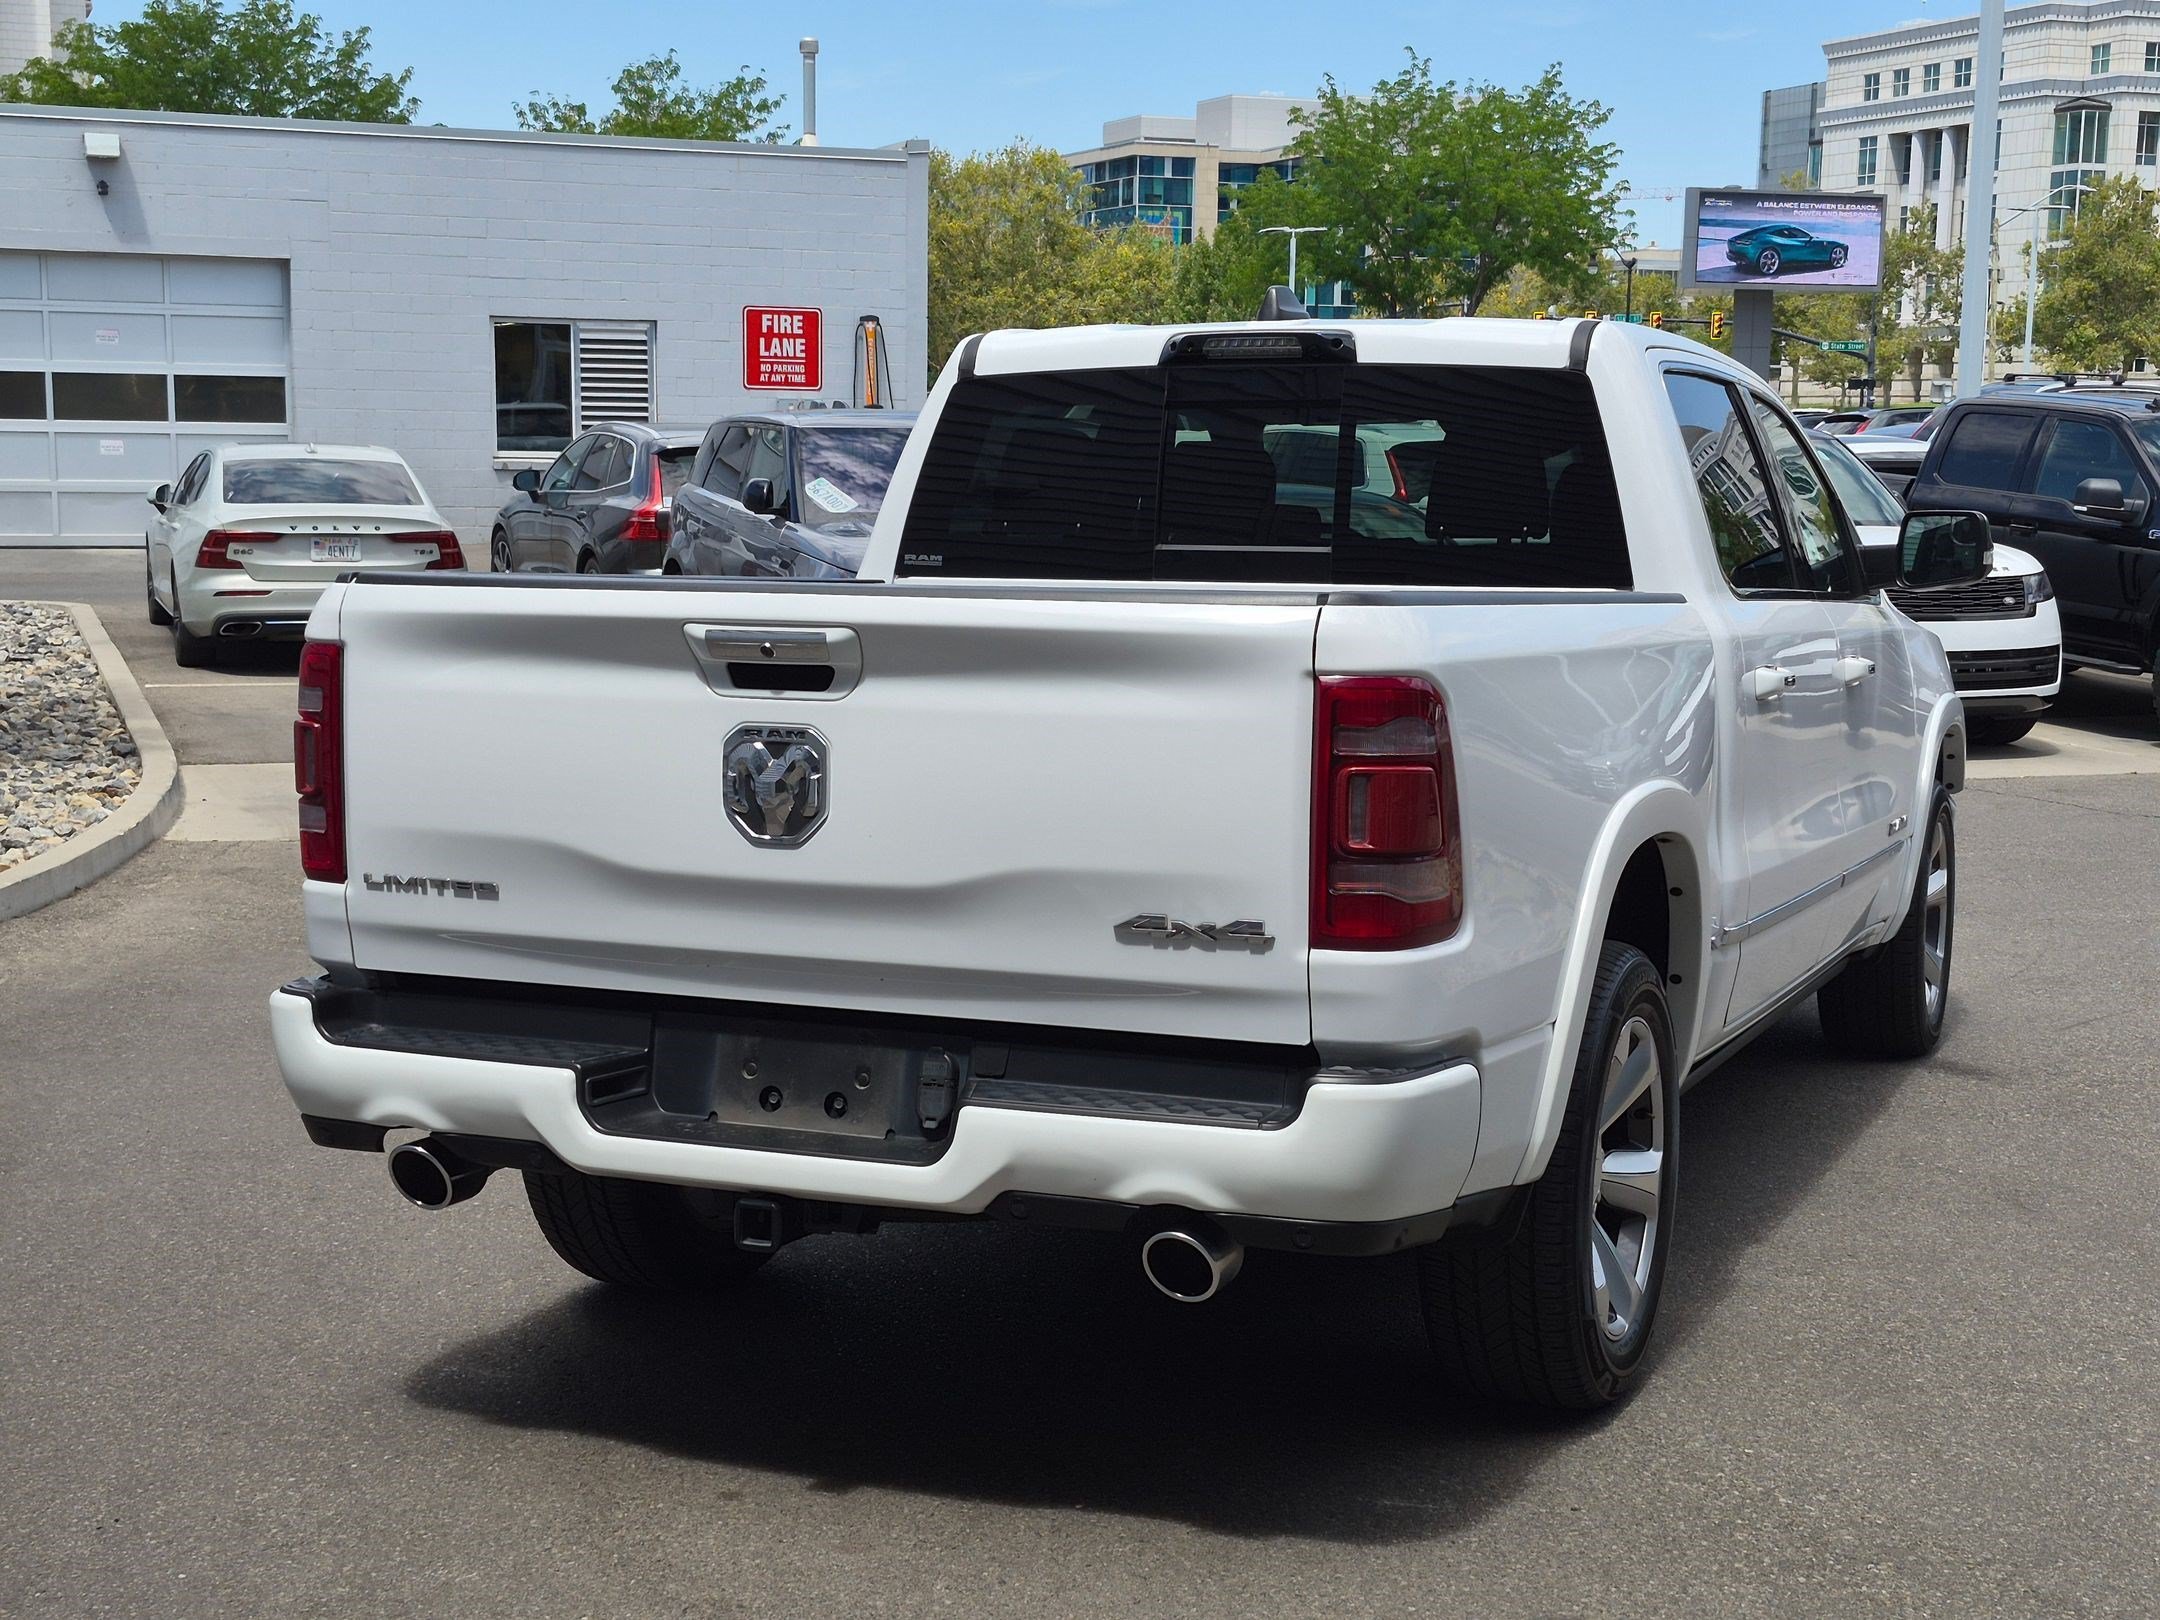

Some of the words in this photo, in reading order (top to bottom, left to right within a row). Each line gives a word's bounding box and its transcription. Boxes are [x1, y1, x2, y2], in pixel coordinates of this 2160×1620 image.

[1763, 201, 1799, 209] BALANCE
[761, 314, 803, 334] FIRE
[759, 337, 806, 357] LANE
[1830, 342, 1845, 350] State
[760, 363, 771, 372] NO
[773, 364, 805, 373] PARKING
[760, 374, 769, 382] AT
[771, 374, 786, 382] ANY
[787, 374, 806, 383] TIME
[744, 728, 806, 740] RAM
[363, 872, 500, 901] LIMITED
